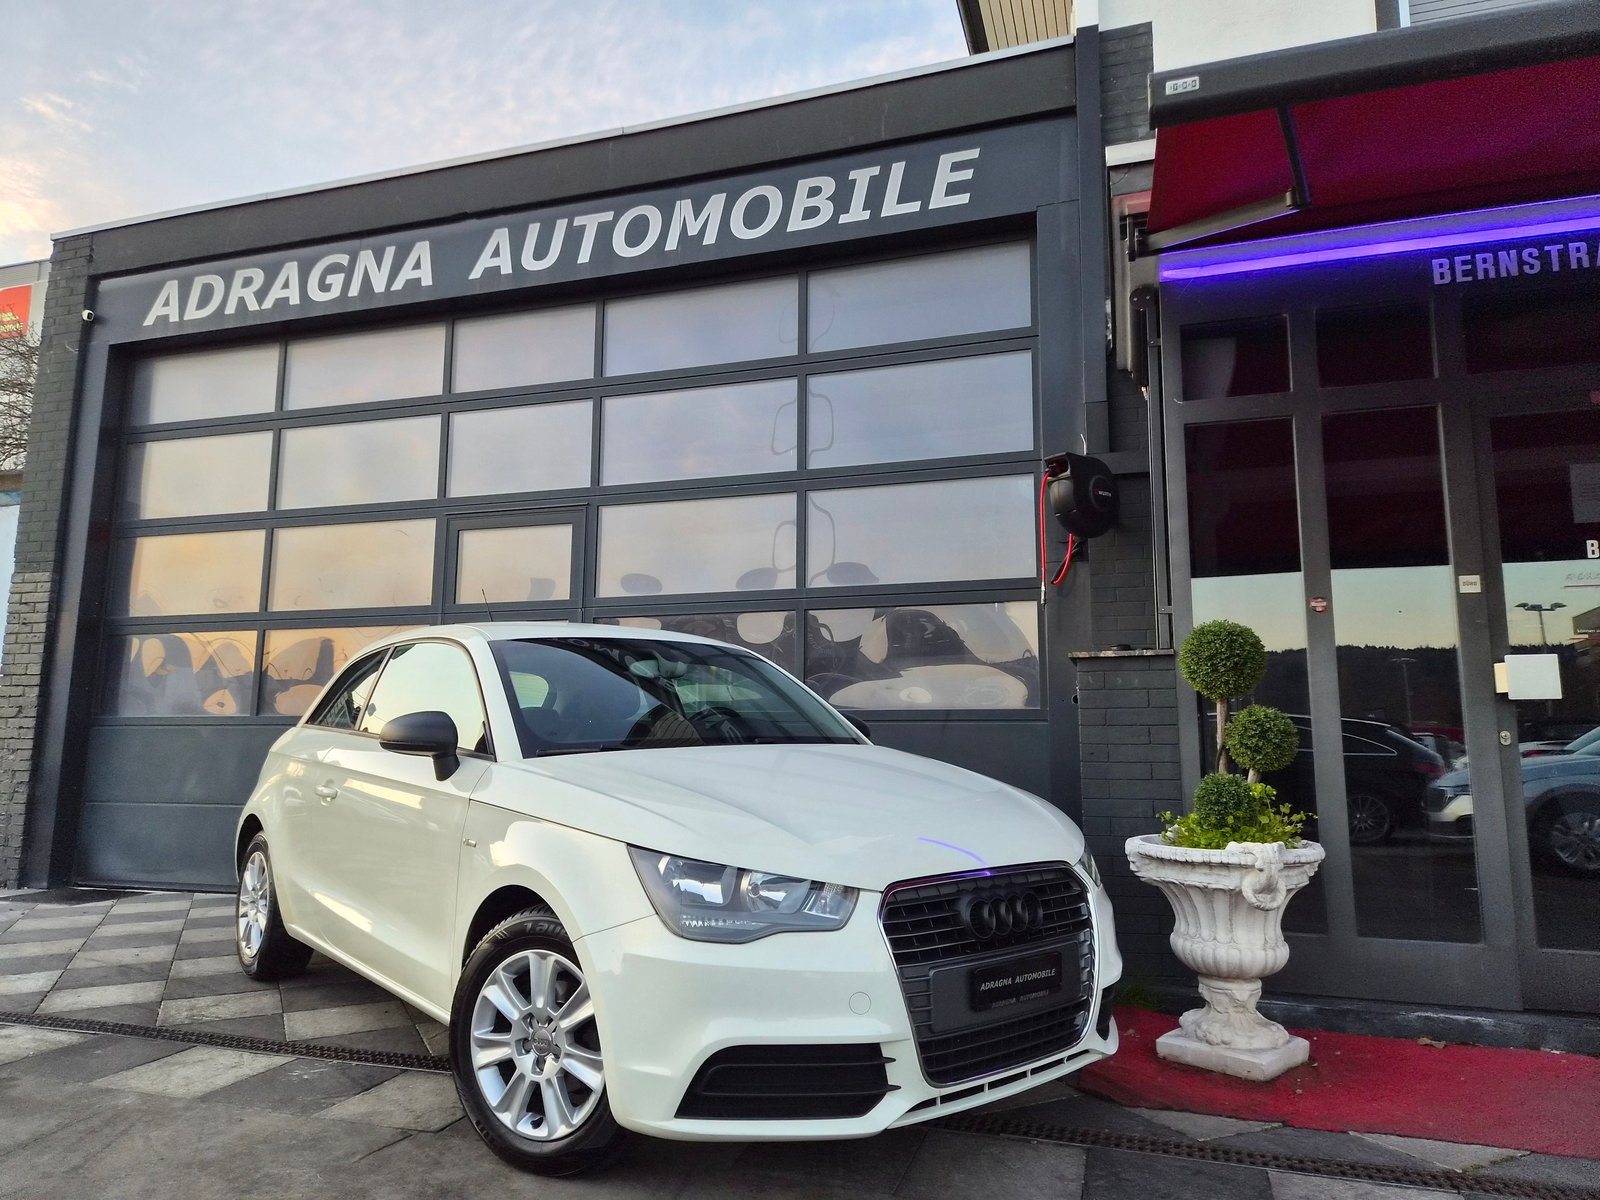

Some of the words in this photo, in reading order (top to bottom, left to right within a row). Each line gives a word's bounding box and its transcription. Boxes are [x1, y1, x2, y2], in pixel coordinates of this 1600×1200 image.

[143, 240, 433, 326] ADRAGNA
[468, 147, 981, 280] AUTOMOBILE
[1431, 241, 1600, 285] BERNSTR
[980, 977, 1012, 991] ADRAGNA
[1014, 968, 1056, 983] AUTOMOBILE
